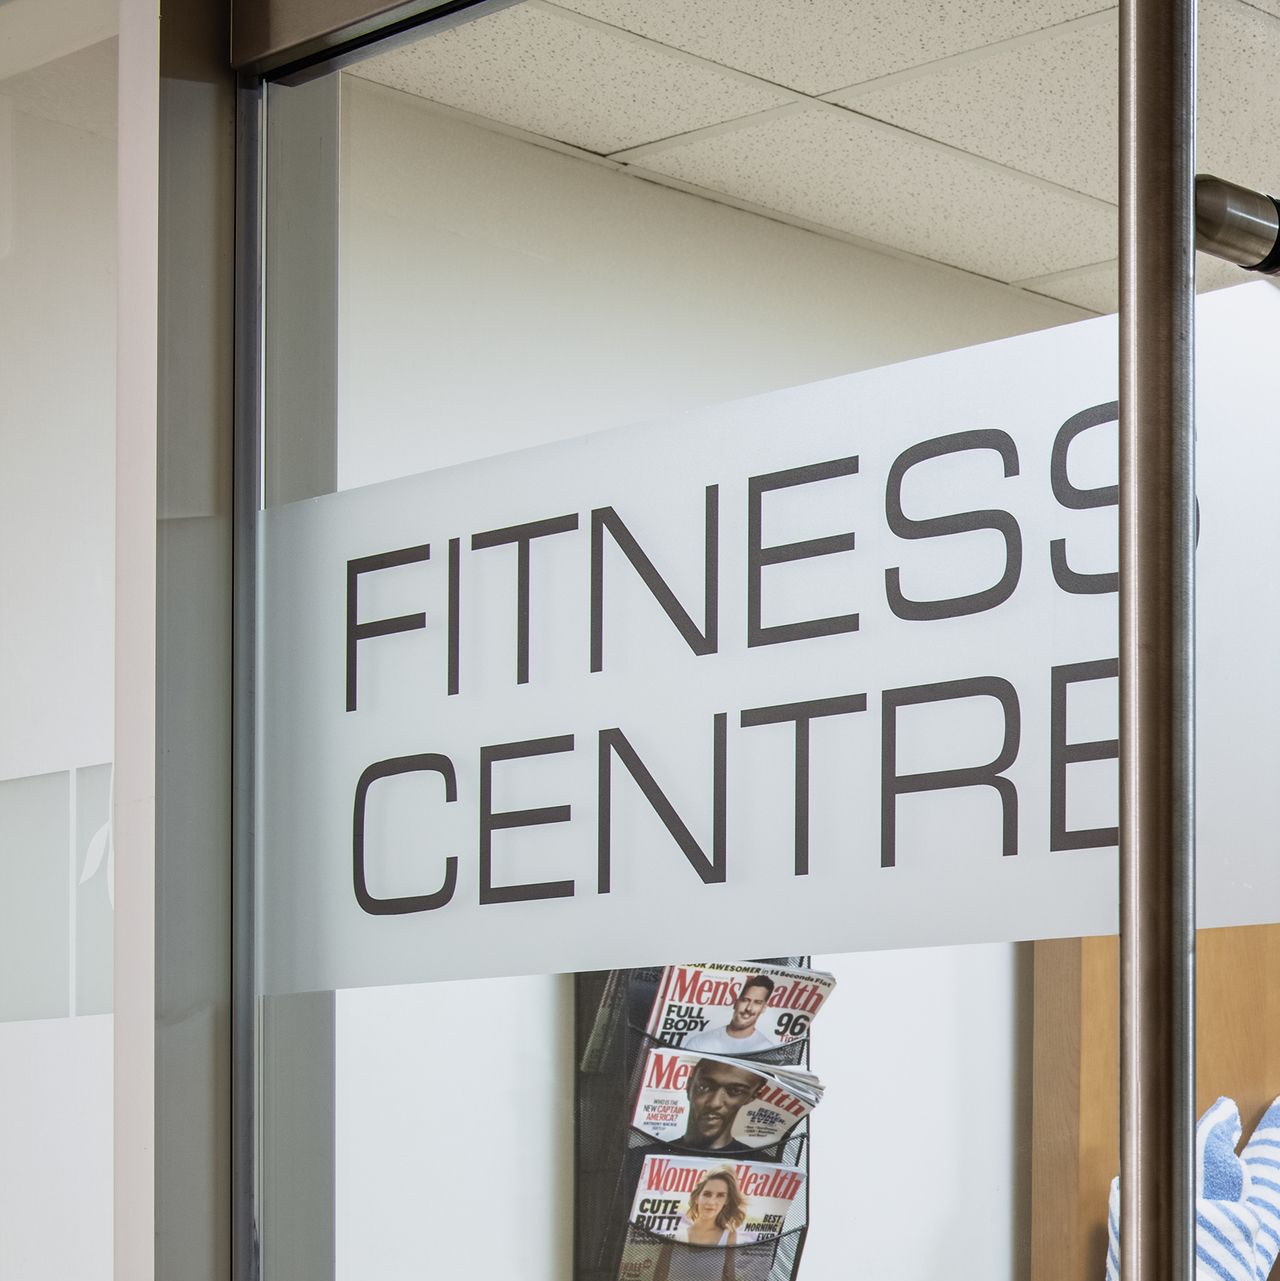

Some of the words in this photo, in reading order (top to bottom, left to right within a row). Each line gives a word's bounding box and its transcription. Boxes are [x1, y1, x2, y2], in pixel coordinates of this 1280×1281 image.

[352, 657, 1119, 915] CENTRE
[709, 962, 761, 974] AWESOMER
[780, 971, 814, 982] Seconds
[815, 978, 832, 988] Flat
[669, 968, 742, 1006] Men's
[746, 975, 824, 1015] alth
[665, 1004, 705, 1019] FULL
[662, 1018, 710, 1032] BODY
[774, 1012, 810, 1036] 96
[658, 1032, 688, 1048] FIT
[756, 1084, 806, 1117] lth
[643, 1104, 657, 1113] NEW
[657, 1105, 685, 1115] CAPTAIN
[646, 1112, 679, 1121] AMERICA?
[646, 1157, 707, 1194] Wom
[735, 1164, 802, 1201] Health
[639, 1198, 681, 1215] CUTE
[634, 1214, 682, 1231] BUTT!
